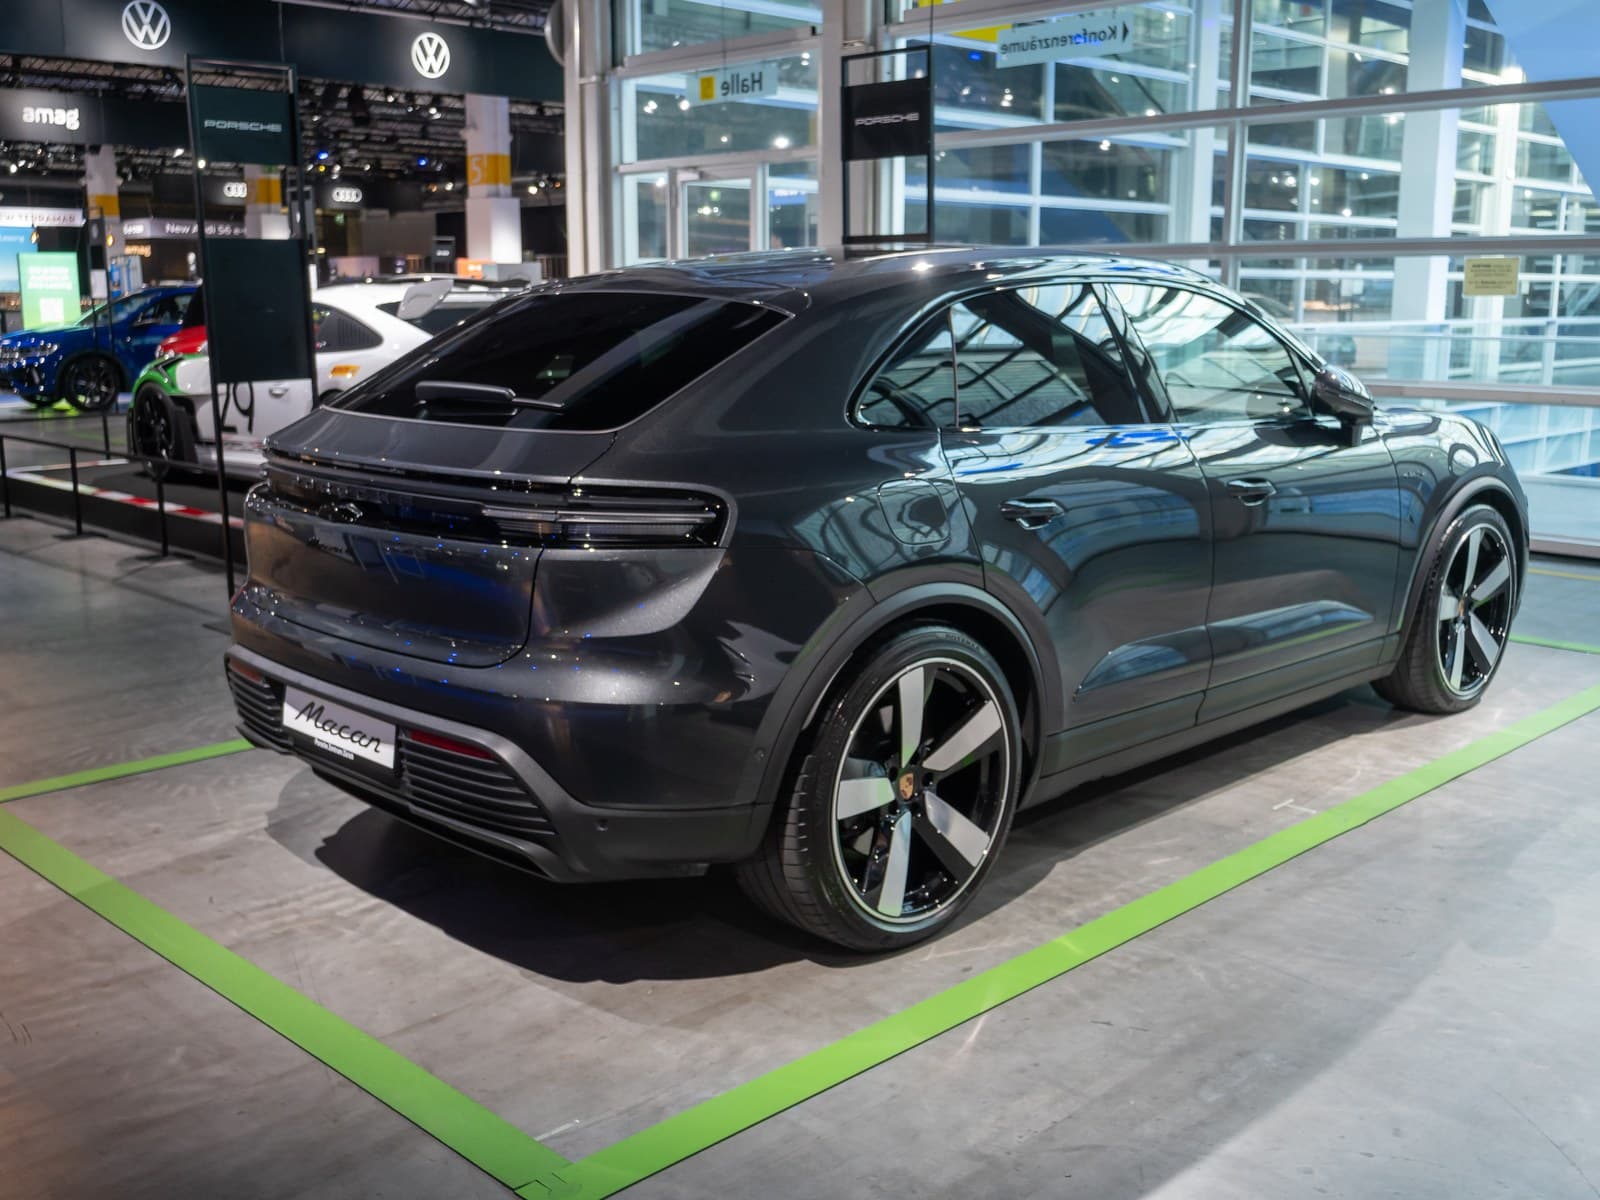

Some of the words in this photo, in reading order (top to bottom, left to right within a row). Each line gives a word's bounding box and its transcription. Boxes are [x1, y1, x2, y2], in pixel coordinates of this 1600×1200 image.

[22, 106, 80, 130] amag
[854, 112, 919, 126] PORSCHE
[203, 119, 282, 132] PORSCHE
[164, 223, 189, 234] New
[191, 223, 216, 235] Adi
[295, 702, 381, 753] Macan
